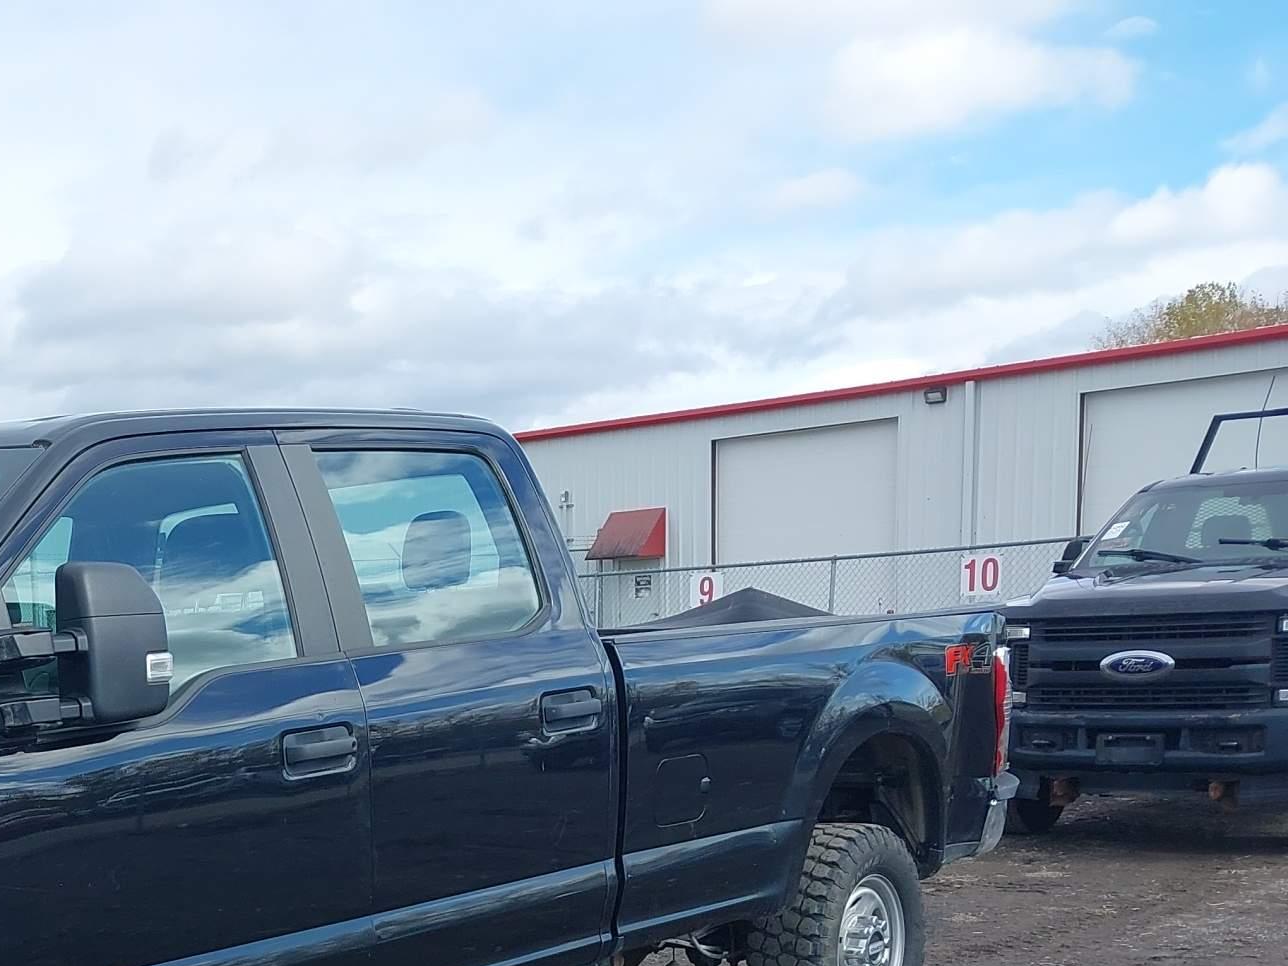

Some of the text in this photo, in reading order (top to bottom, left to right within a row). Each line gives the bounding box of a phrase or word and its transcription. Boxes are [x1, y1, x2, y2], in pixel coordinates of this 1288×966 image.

[964, 558, 999, 592] 10
[699, 576, 714, 606] 9
[1118, 657, 1154, 674] Ford
